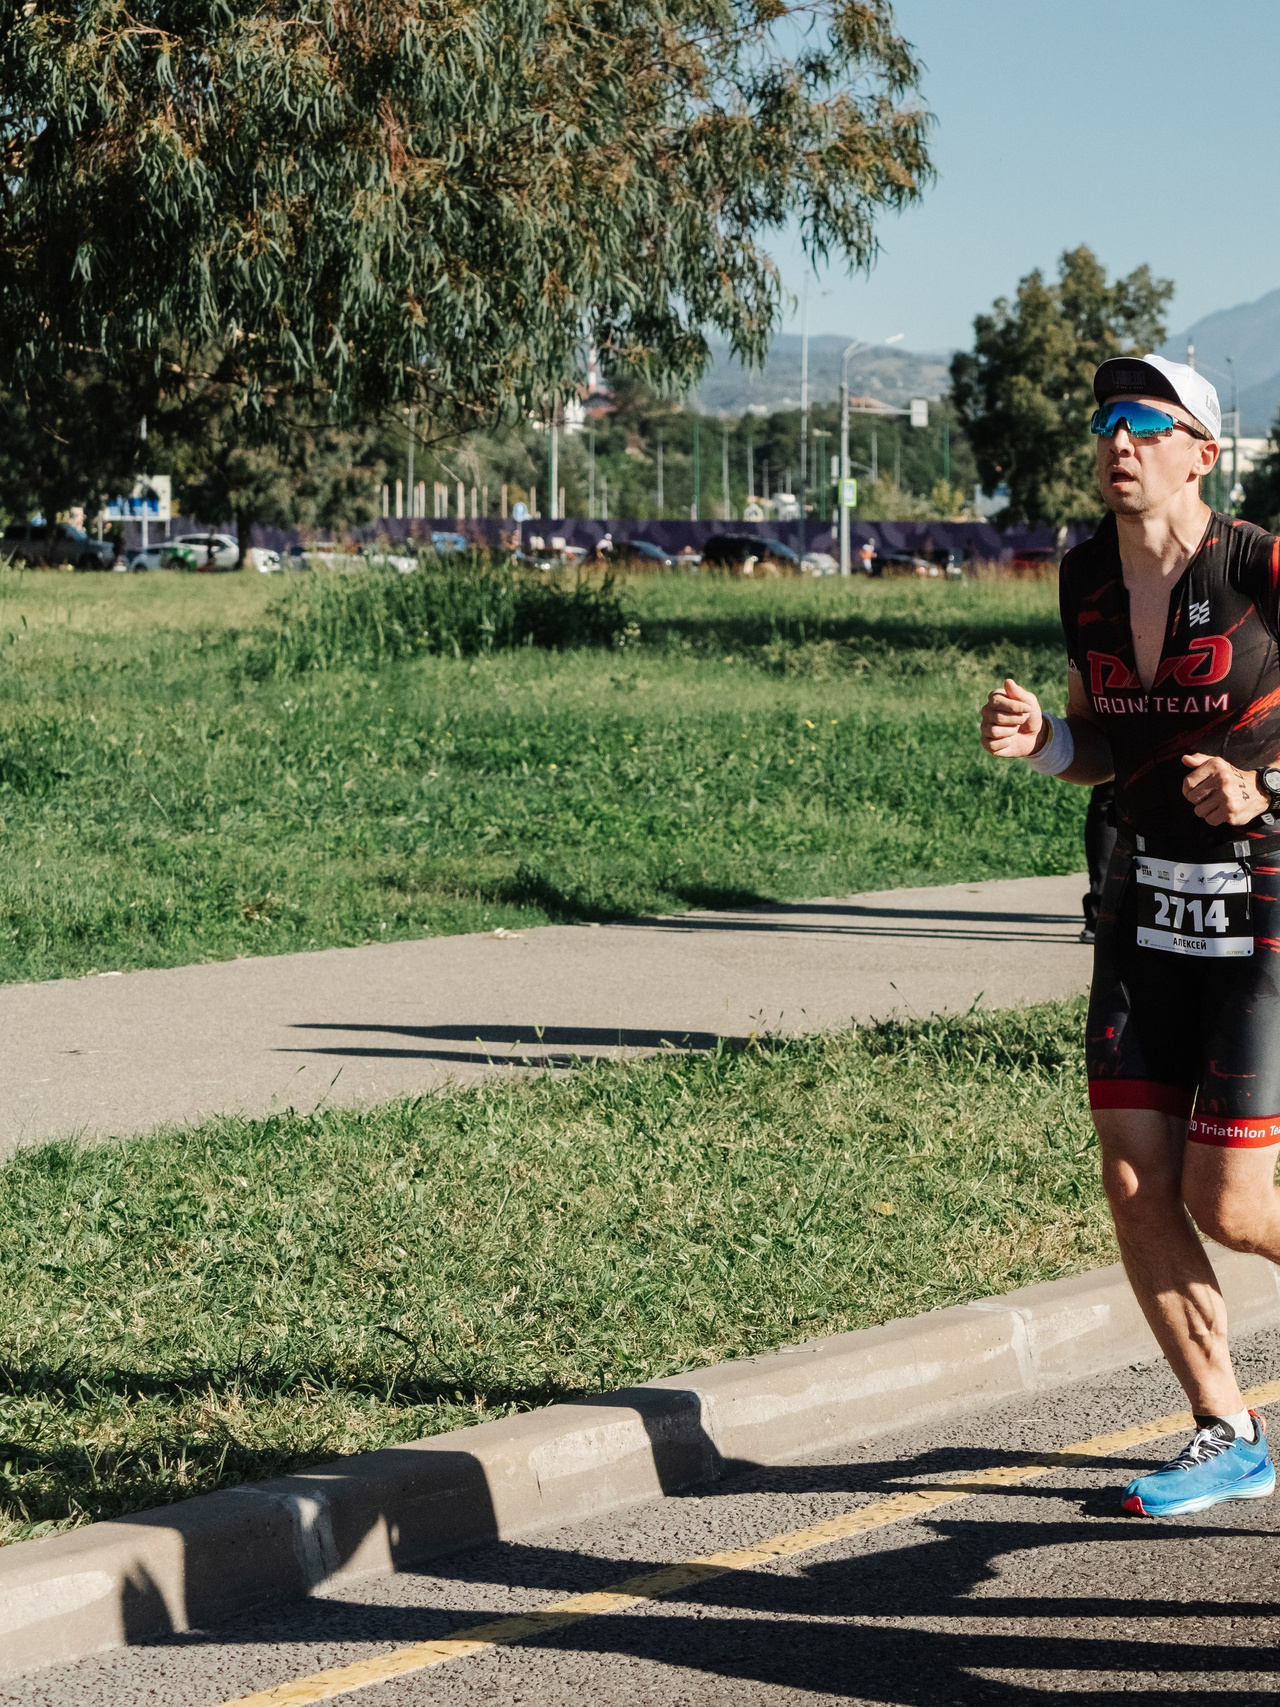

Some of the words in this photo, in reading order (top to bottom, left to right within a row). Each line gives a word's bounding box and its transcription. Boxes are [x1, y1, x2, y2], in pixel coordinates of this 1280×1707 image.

[1093, 695, 1145, 714] IRON
[1152, 692, 1230, 713] TEAM
[1153, 892, 1230, 933] 2714
[1172, 936, 1207, 951] АЛЕКСЕЙ
[1200, 1122, 1266, 1139] Triathlon
